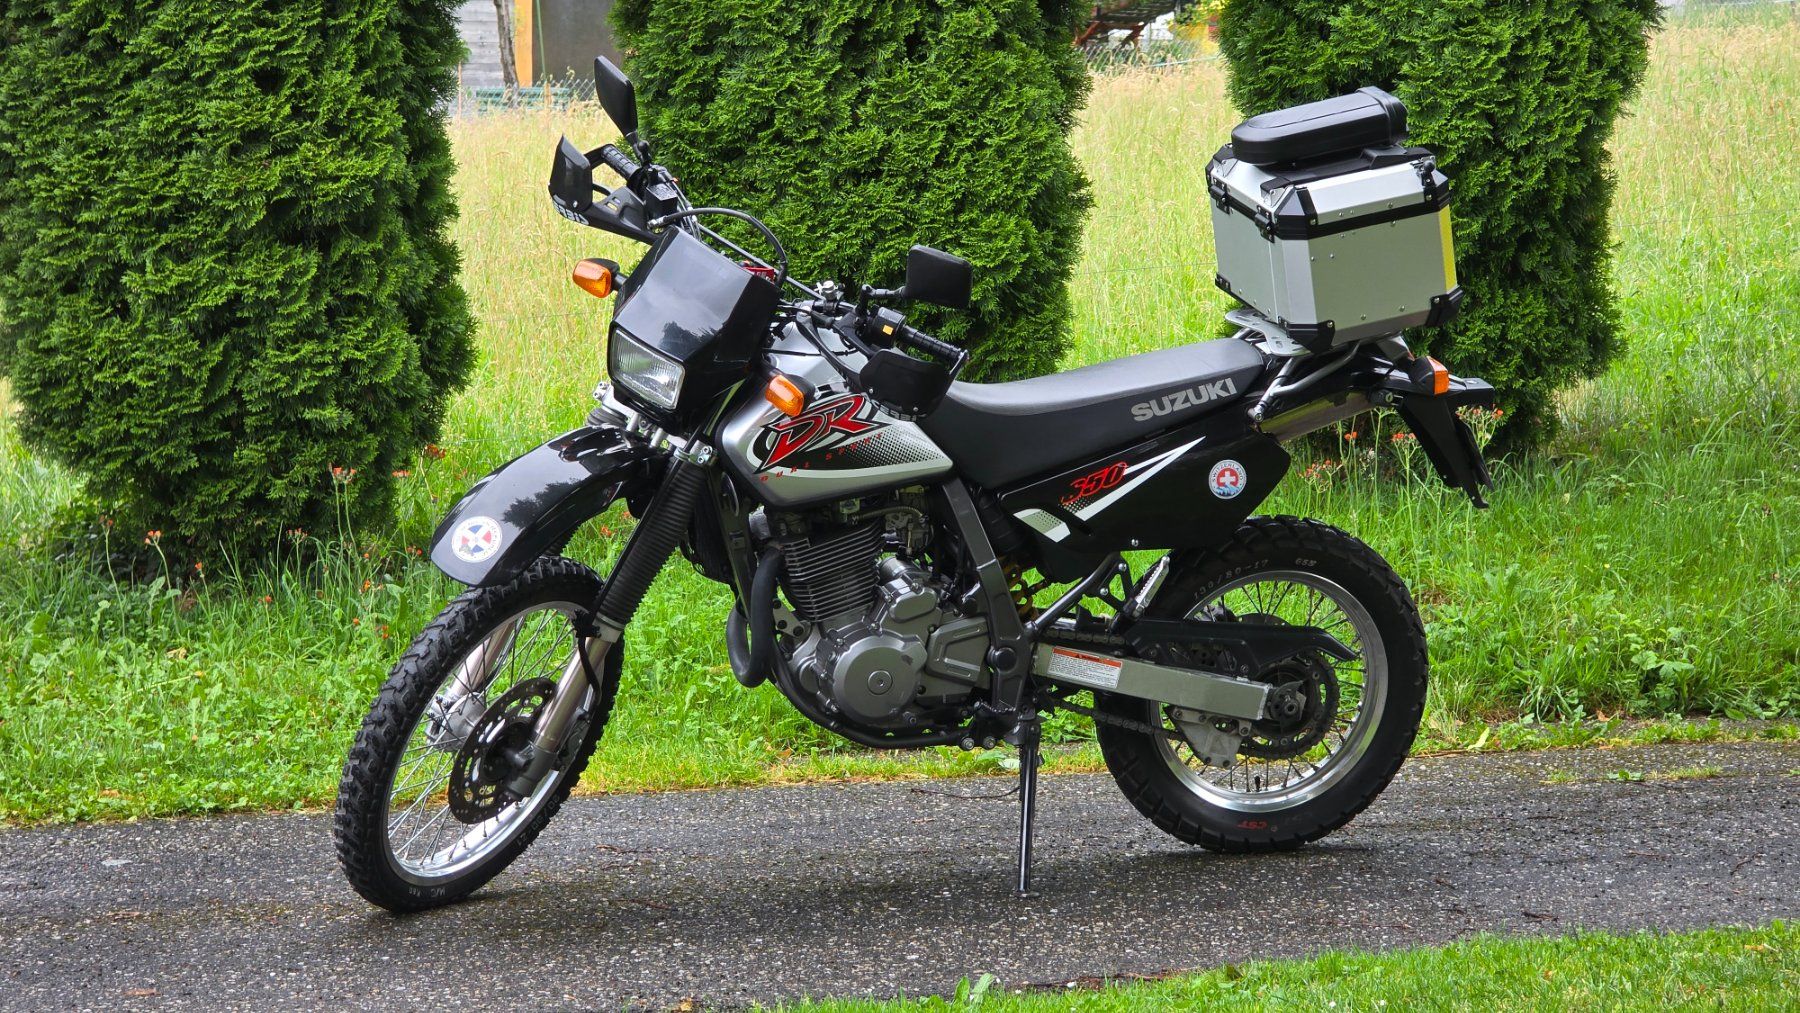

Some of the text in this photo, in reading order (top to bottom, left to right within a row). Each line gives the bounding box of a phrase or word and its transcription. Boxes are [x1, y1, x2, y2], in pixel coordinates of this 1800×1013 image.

[1131, 377, 1238, 422] SUZUKI
[757, 394, 884, 472] DR
[1237, 819, 1268, 830] CST
